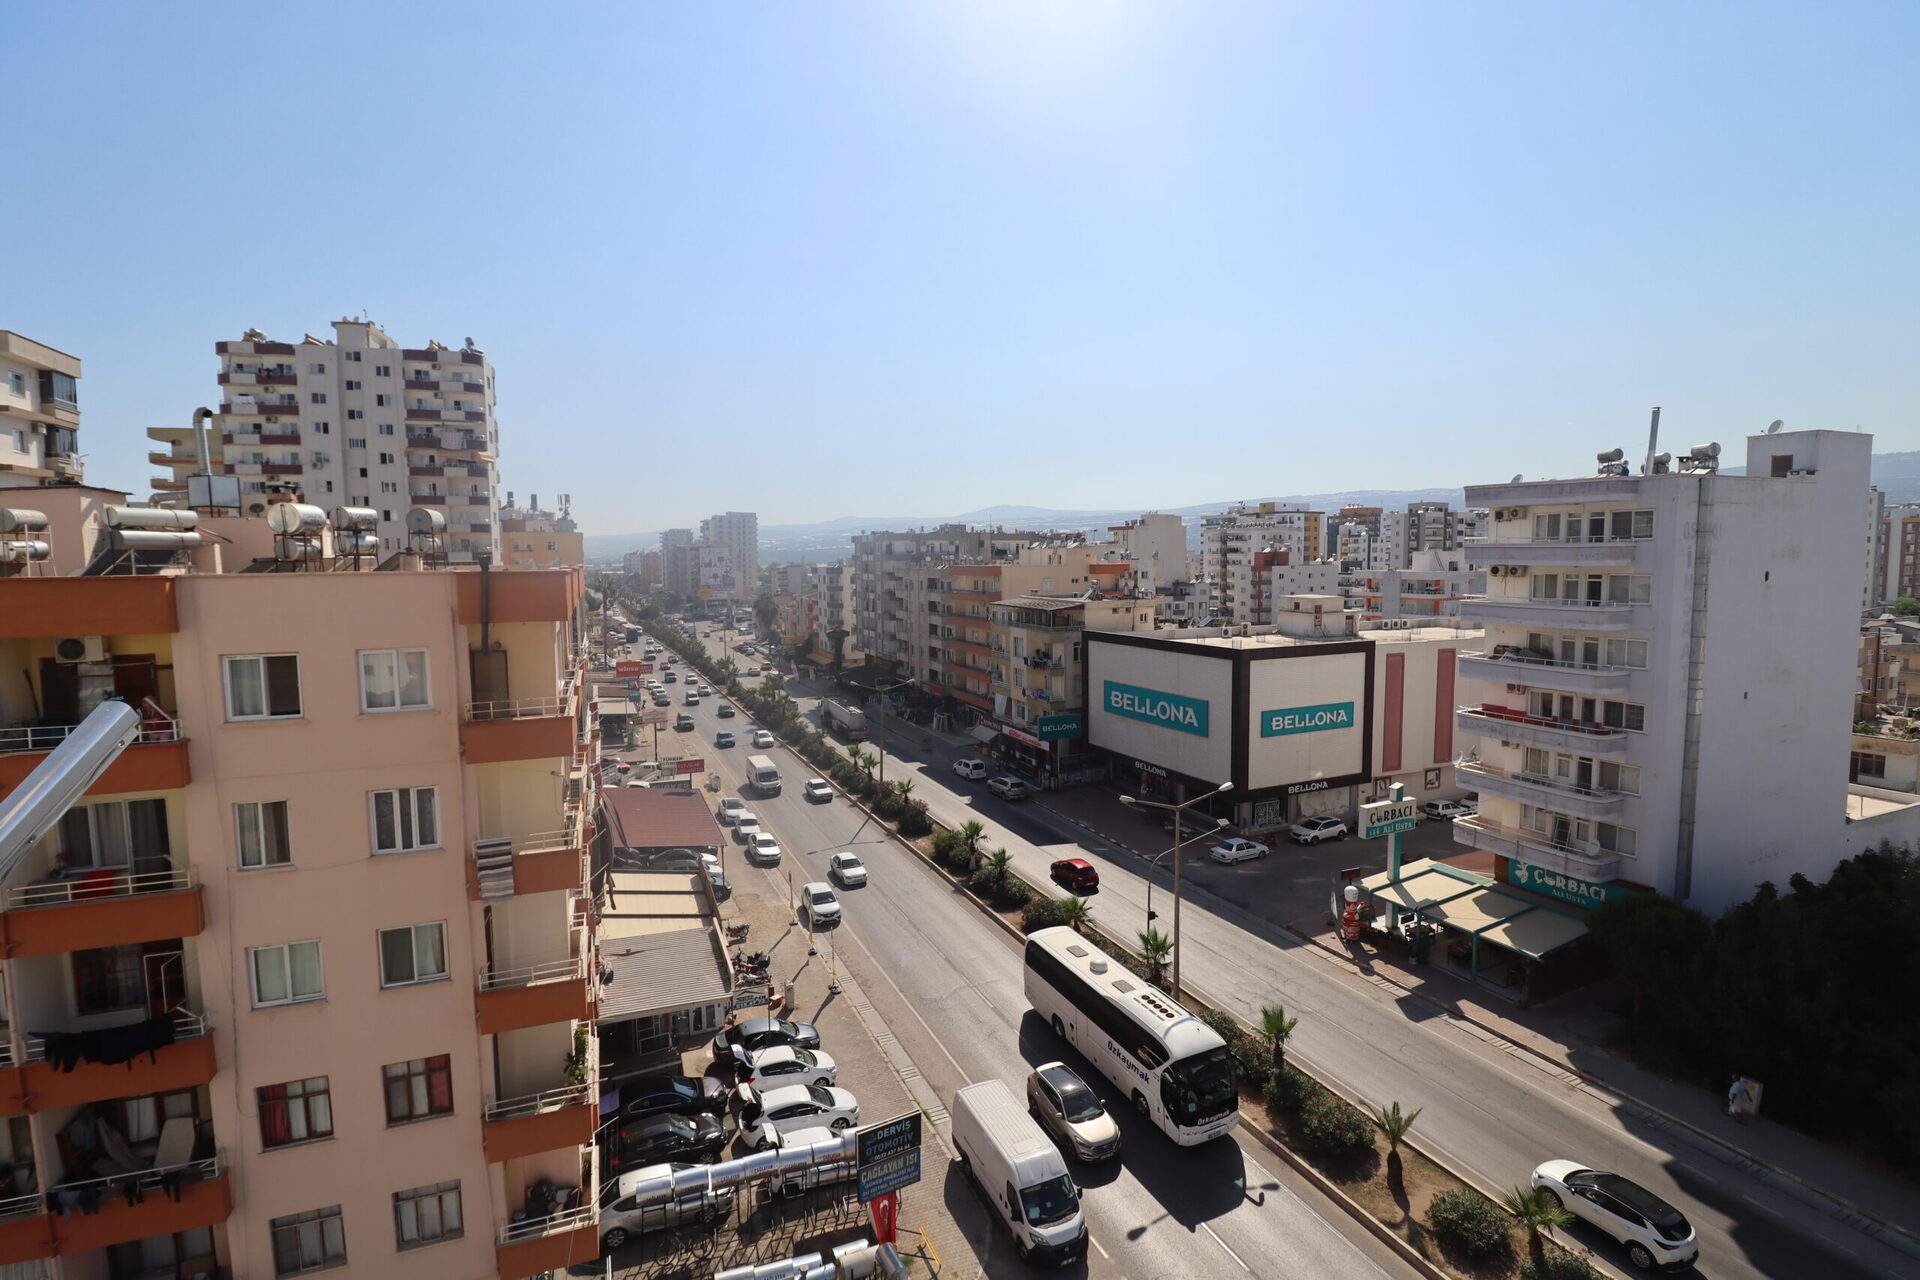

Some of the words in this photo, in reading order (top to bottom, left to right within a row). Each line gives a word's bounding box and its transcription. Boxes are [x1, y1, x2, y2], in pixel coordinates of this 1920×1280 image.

[1110, 691, 1199, 727] BELLONA
[1271, 710, 1348, 730] BELLONA
[1042, 723, 1077, 732] BELLONA
[1135, 761, 1166, 777] BELLONA
[1288, 781, 1328, 794] BELLONA
[1395, 822, 1412, 830] USTA
